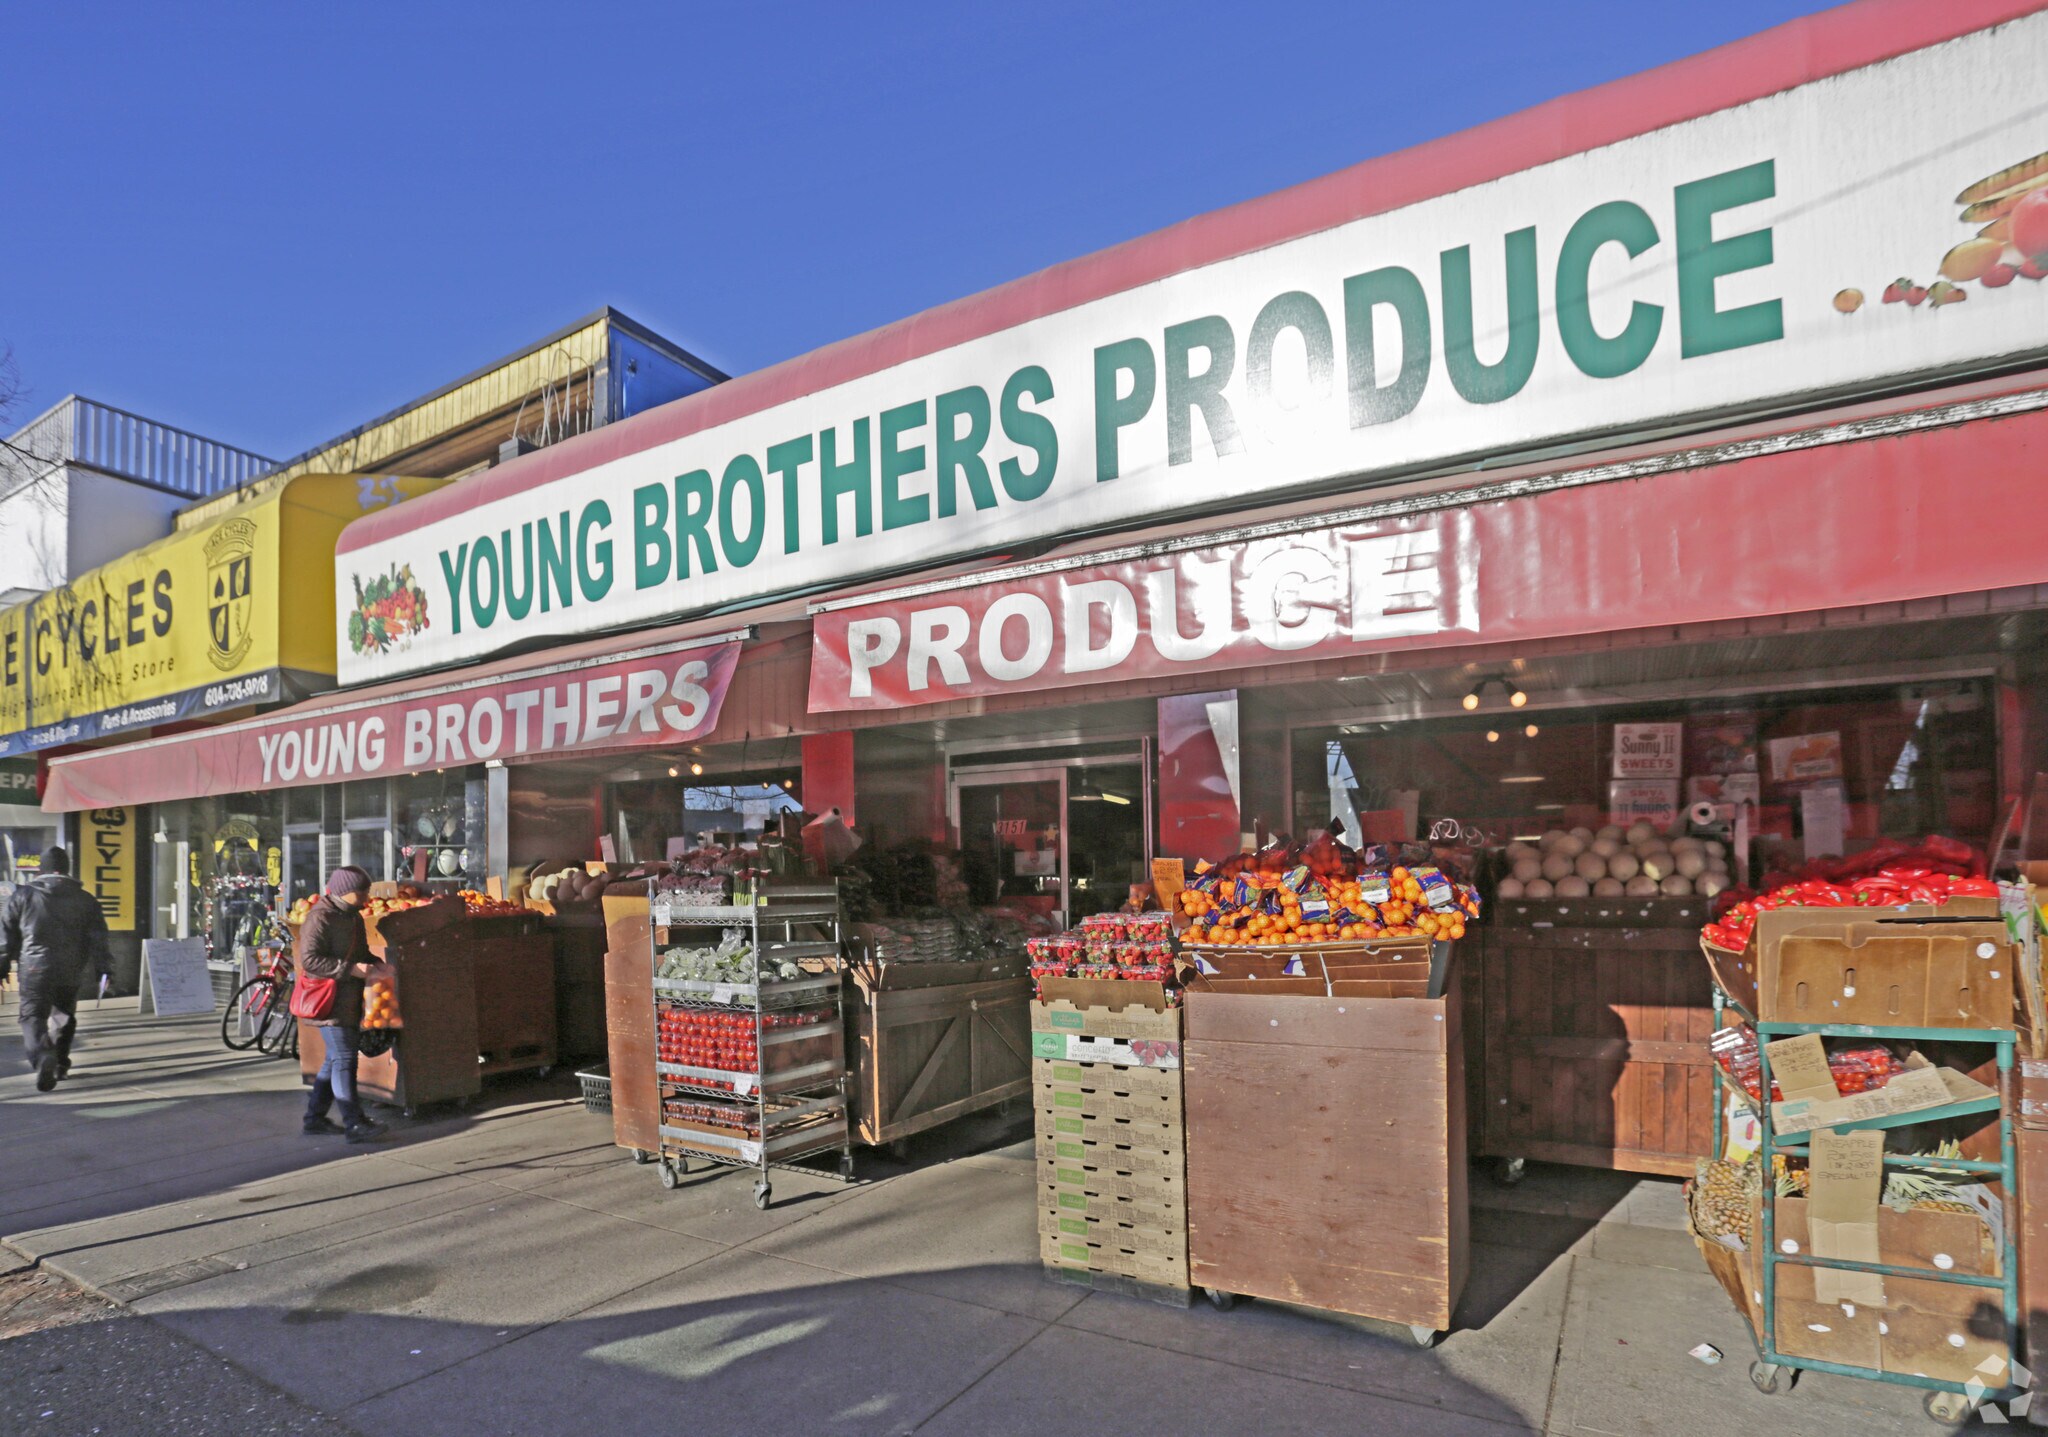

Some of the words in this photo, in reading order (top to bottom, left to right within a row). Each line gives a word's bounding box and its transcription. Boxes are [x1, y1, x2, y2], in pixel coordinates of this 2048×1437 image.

[440, 500, 613, 633] YOUNG
[635, 367, 1057, 590] BROTHERS
[1096, 160, 1784, 480] PRODUCE
[36, 568, 173, 676] CYCLES
[847, 528, 1440, 698] PRODUCE
[132, 657, 174, 681] Store
[258, 716, 386, 783] YOUNG
[404, 660, 710, 766] BROTHERS
[1621, 736, 1660, 757] Sunny
[1620, 759, 1674, 769] SWEETS
[997, 821, 1025, 833] 3151
[1818, 1138, 1877, 1149] PINEAPPLE
